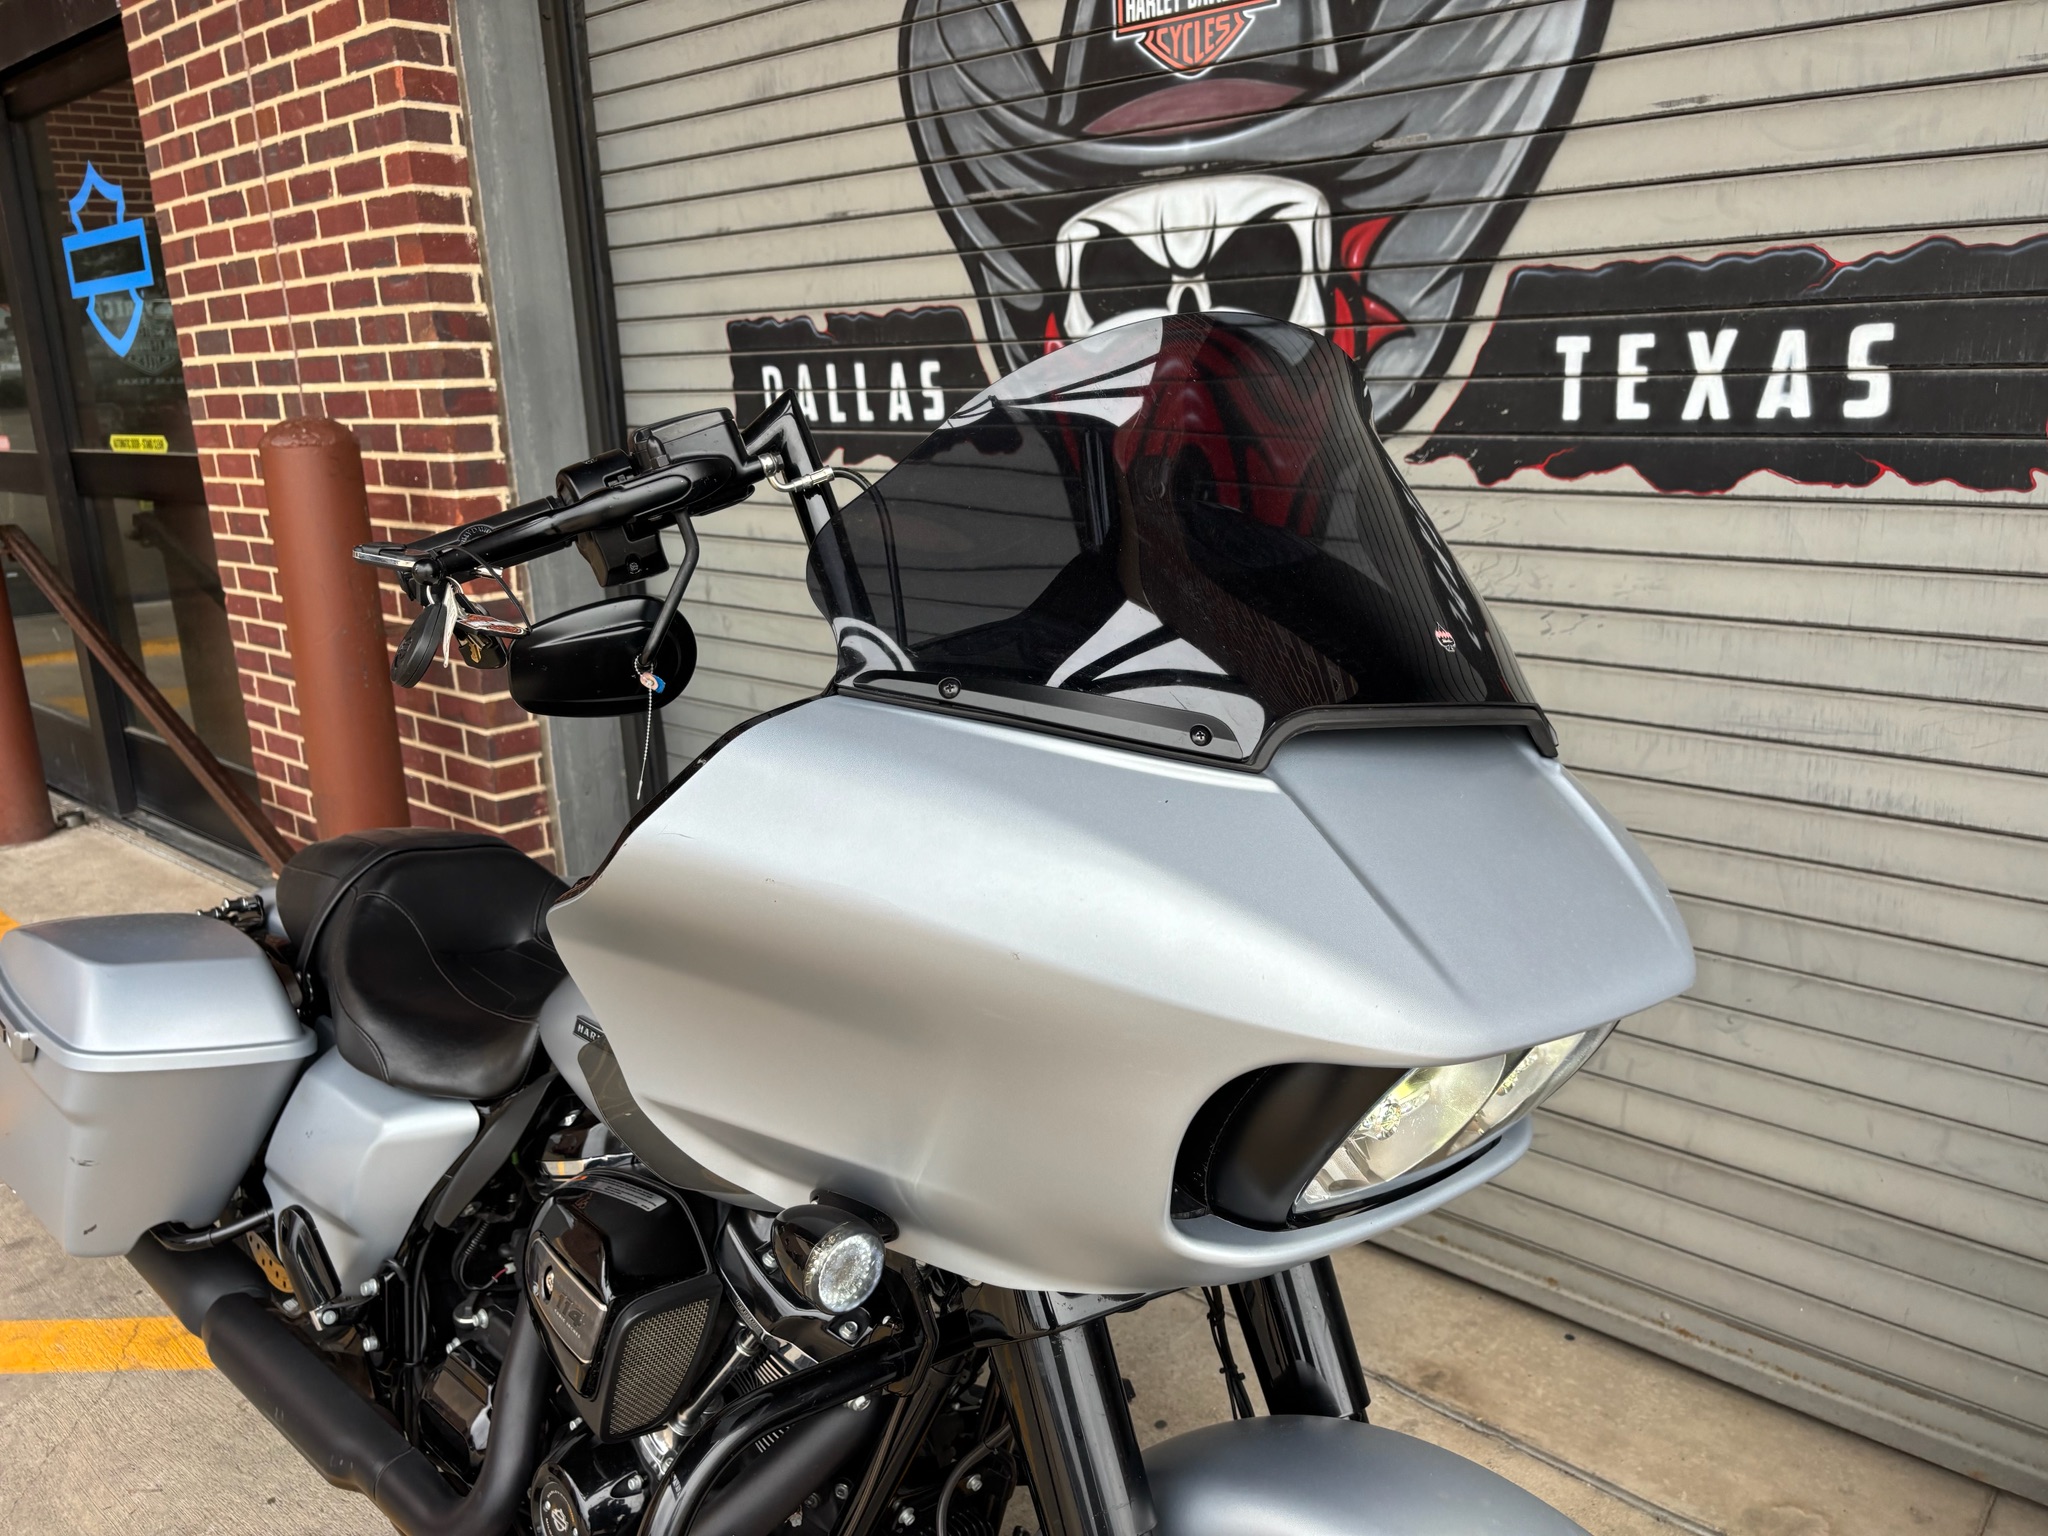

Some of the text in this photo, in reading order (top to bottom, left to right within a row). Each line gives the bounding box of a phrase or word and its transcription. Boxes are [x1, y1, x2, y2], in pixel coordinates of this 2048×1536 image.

[1156, 14, 1231, 65] CYCLES
[762, 360, 945, 423] DALLAS
[1556, 322, 1895, 421] TEXAS
[577, 1023, 601, 1041] HAR
[556, 1292, 585, 1328] 114
